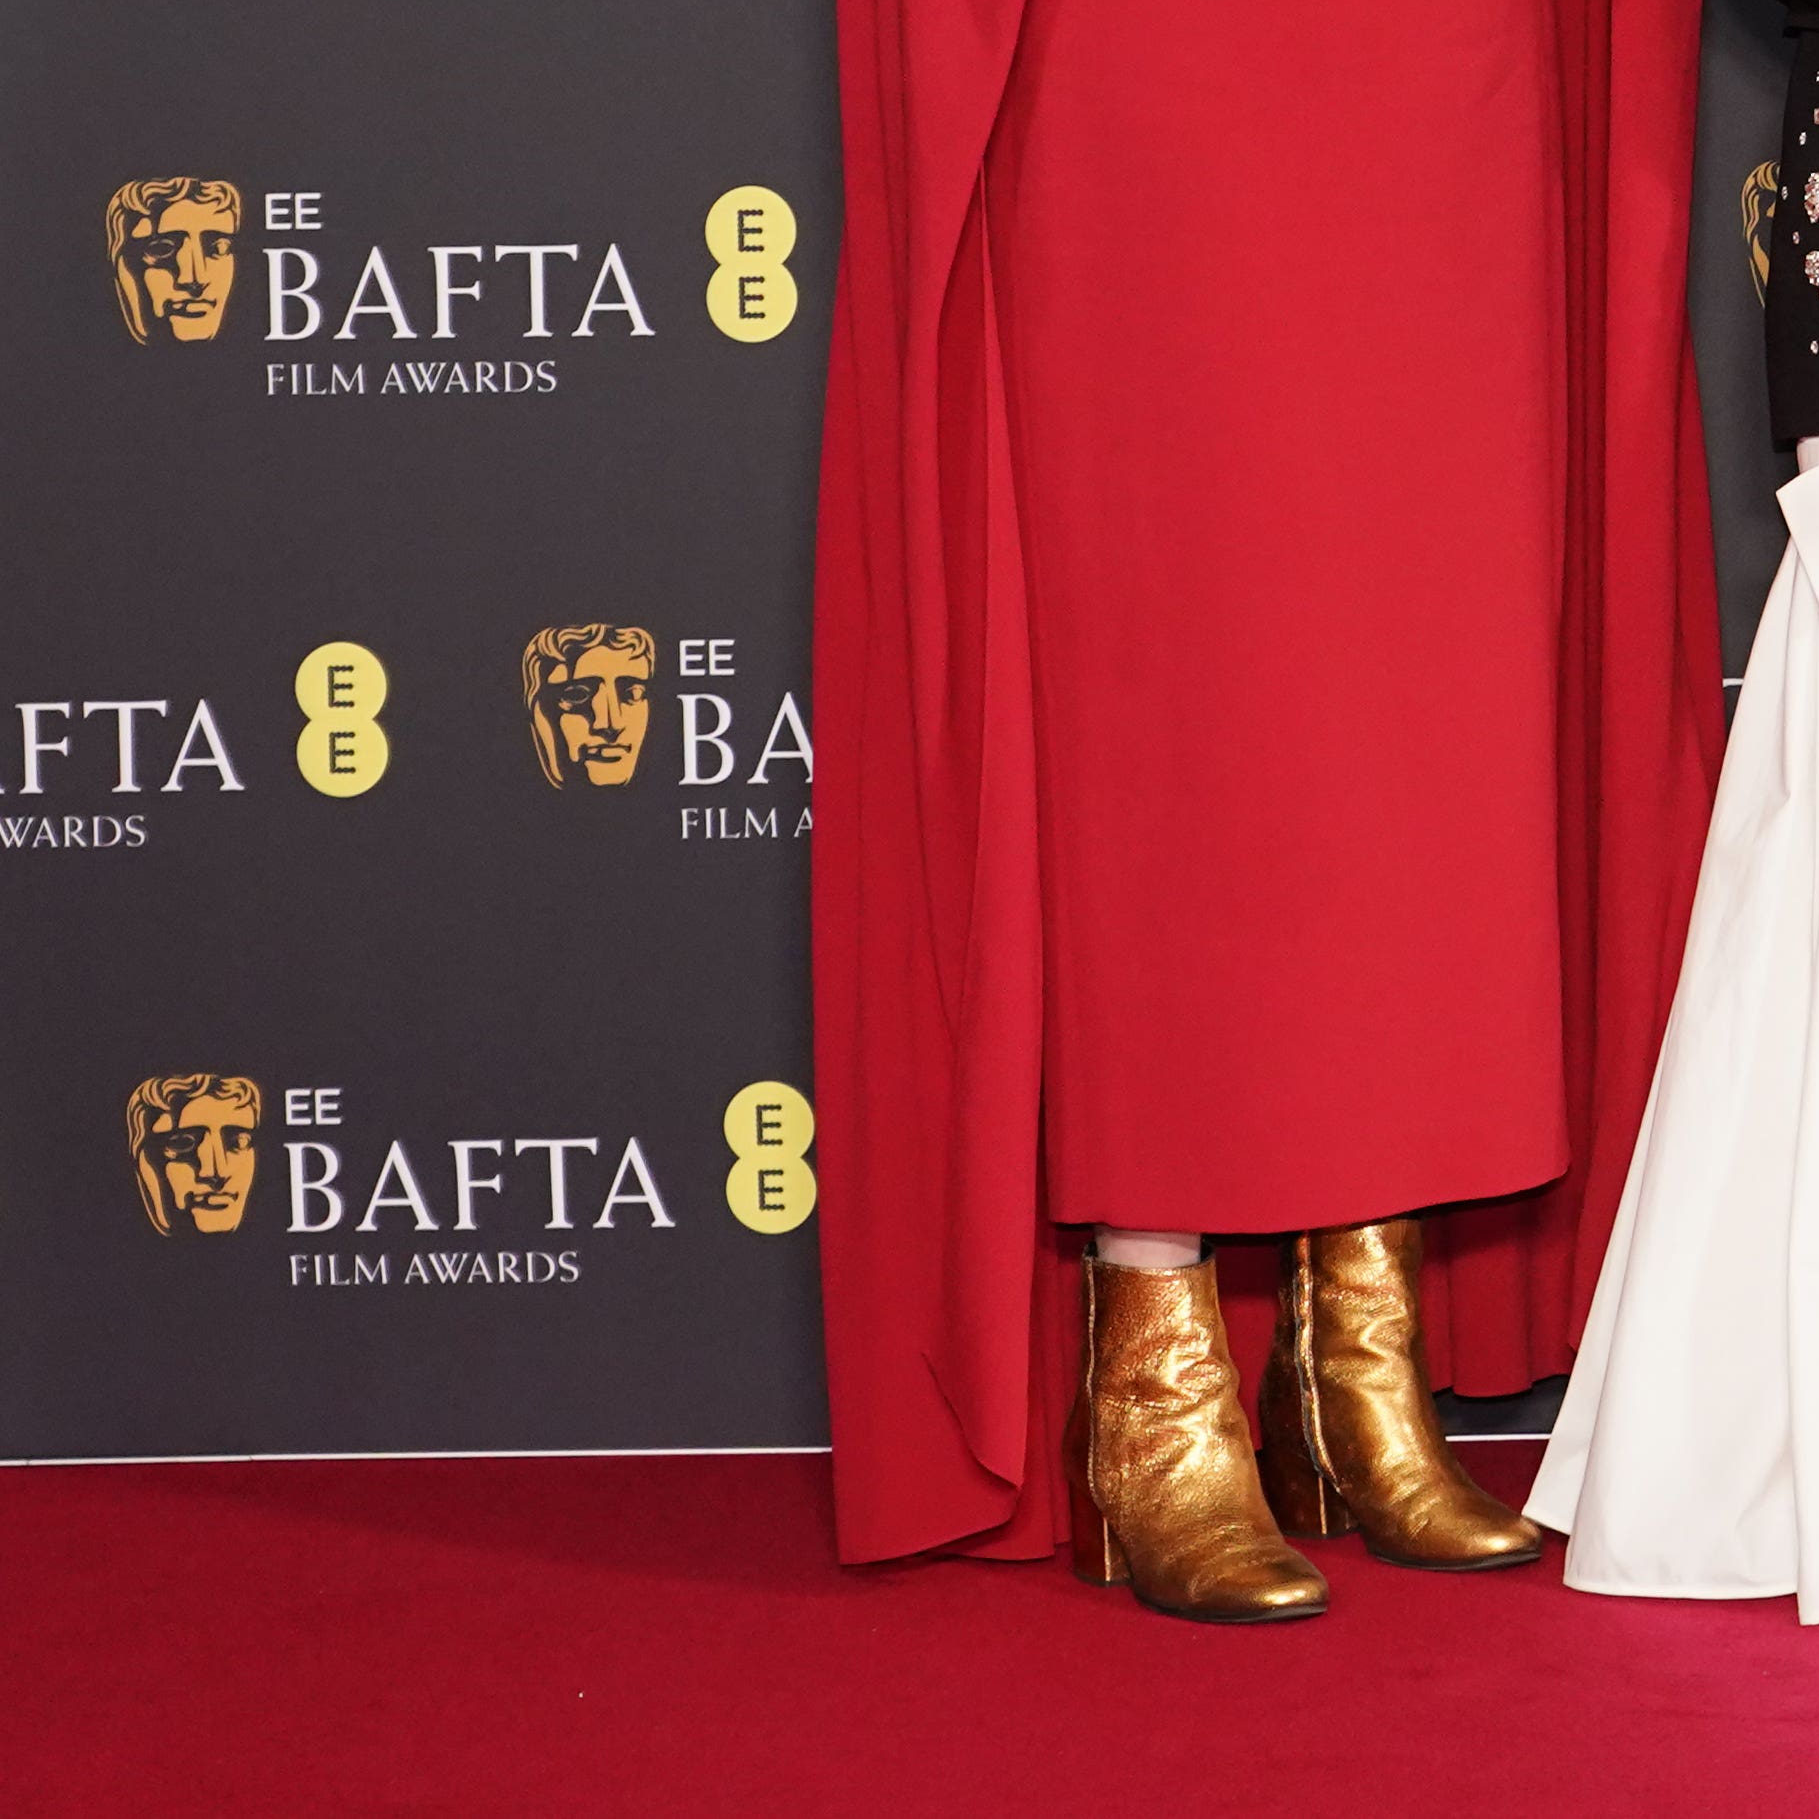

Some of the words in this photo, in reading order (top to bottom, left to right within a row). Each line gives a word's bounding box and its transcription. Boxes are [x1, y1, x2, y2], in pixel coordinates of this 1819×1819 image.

[265, 193, 321, 230] EE
[263, 243, 655, 340] BAFTA
[268, 364, 364, 395] FILM
[381, 361, 556, 393] AWARDS
[680, 639, 734, 675] EE
[0, 699, 244, 794] FTA
[682, 808, 777, 838] FILM
[286, 1089, 341, 1125] EE
[284, 1137, 675, 1232] BAFTA
[290, 1255, 387, 1285] FILM
[405, 1252, 578, 1283] AWARDS
